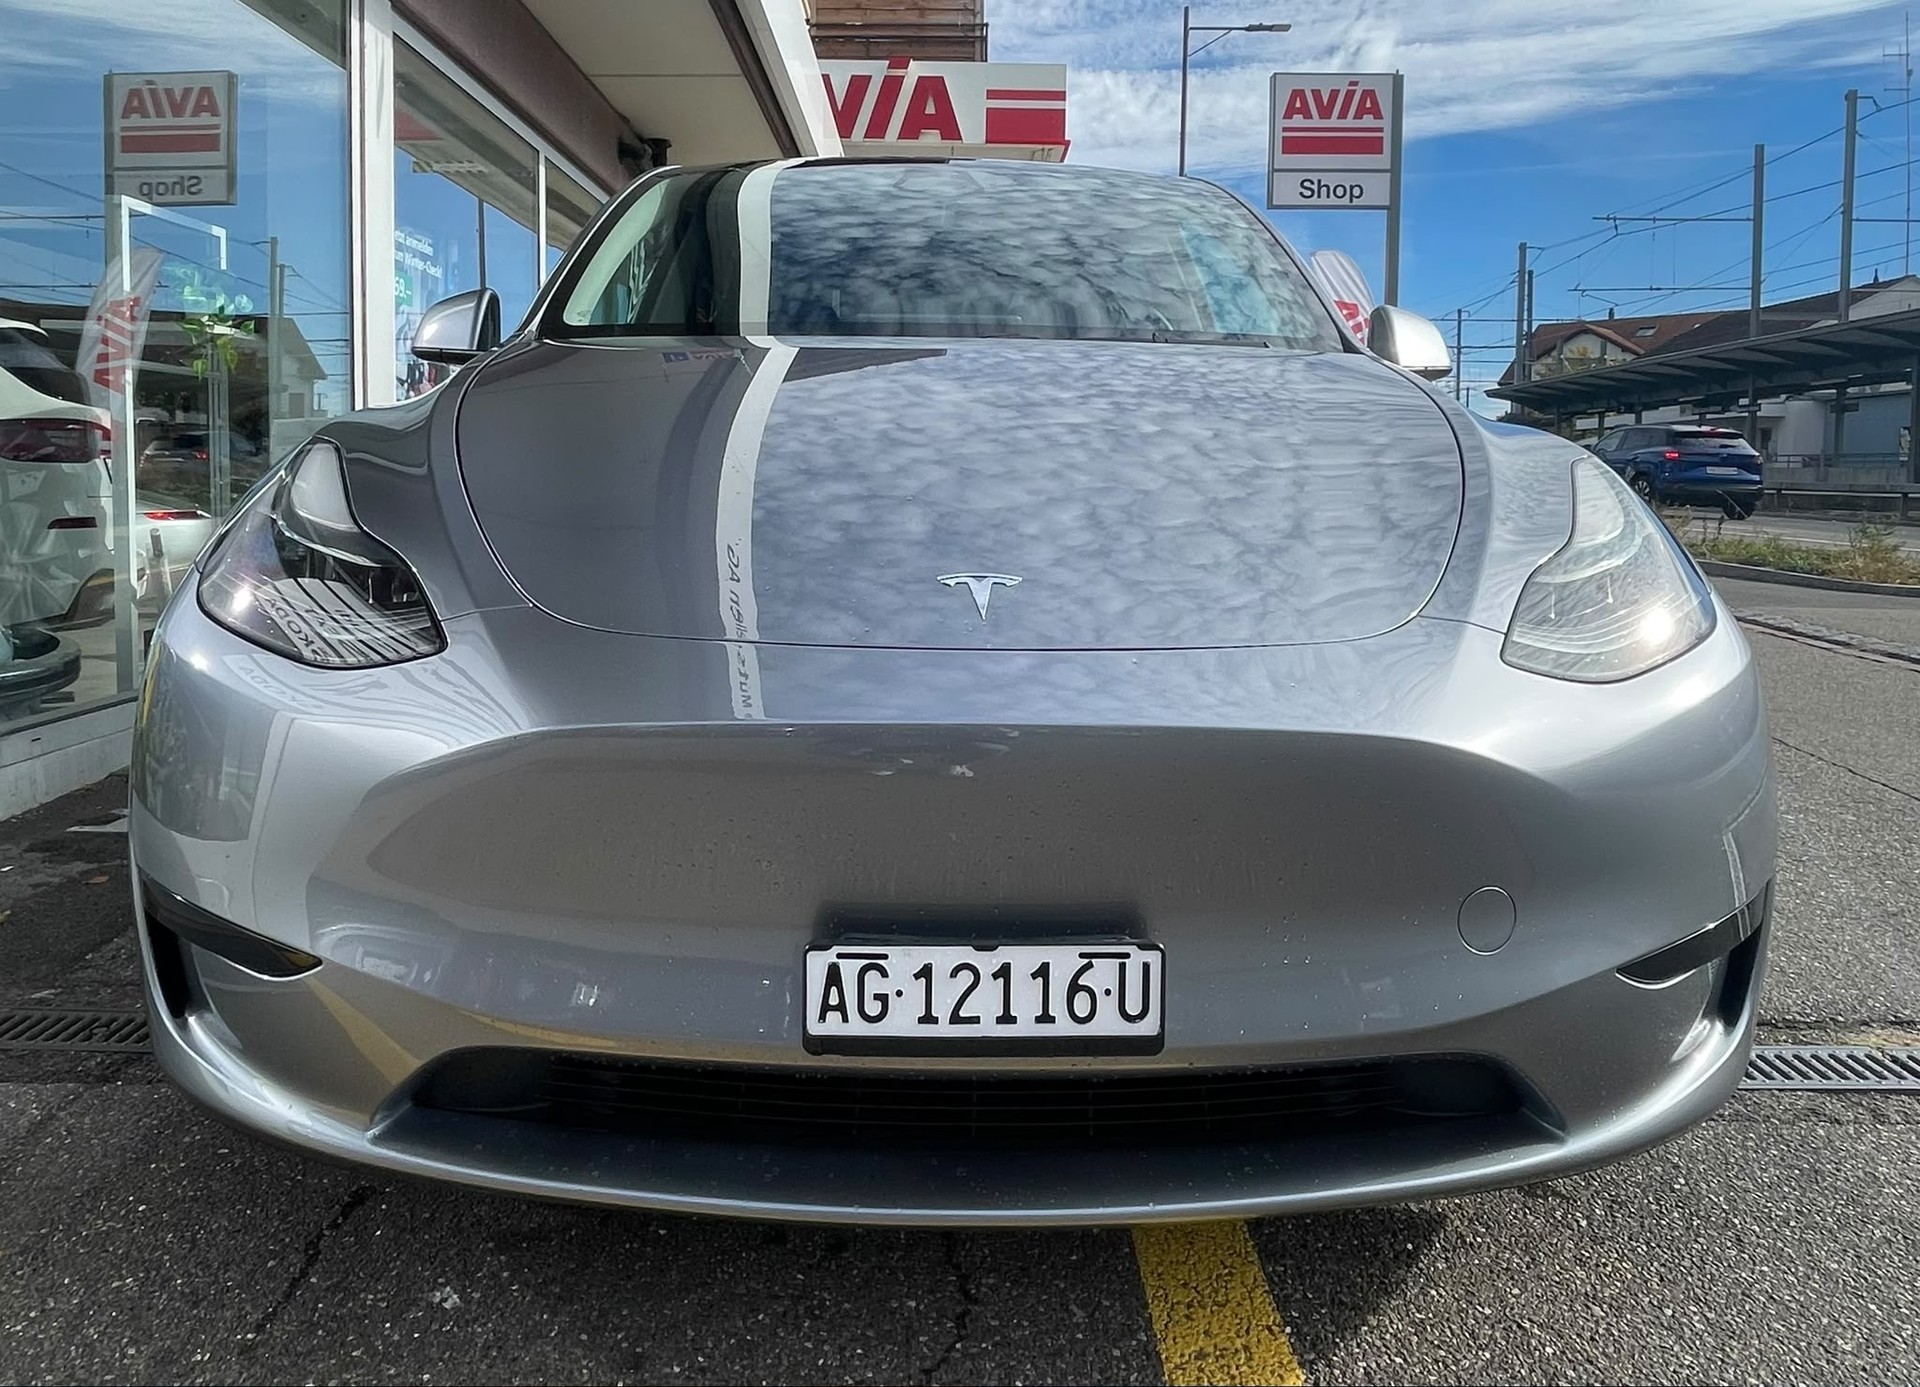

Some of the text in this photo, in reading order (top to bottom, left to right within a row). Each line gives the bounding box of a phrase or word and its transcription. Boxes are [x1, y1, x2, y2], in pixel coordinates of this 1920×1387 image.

[820, 56, 964, 141] VIA
[1281, 80, 1384, 120] AVIA
[1298, 178, 1364, 204] Shop
